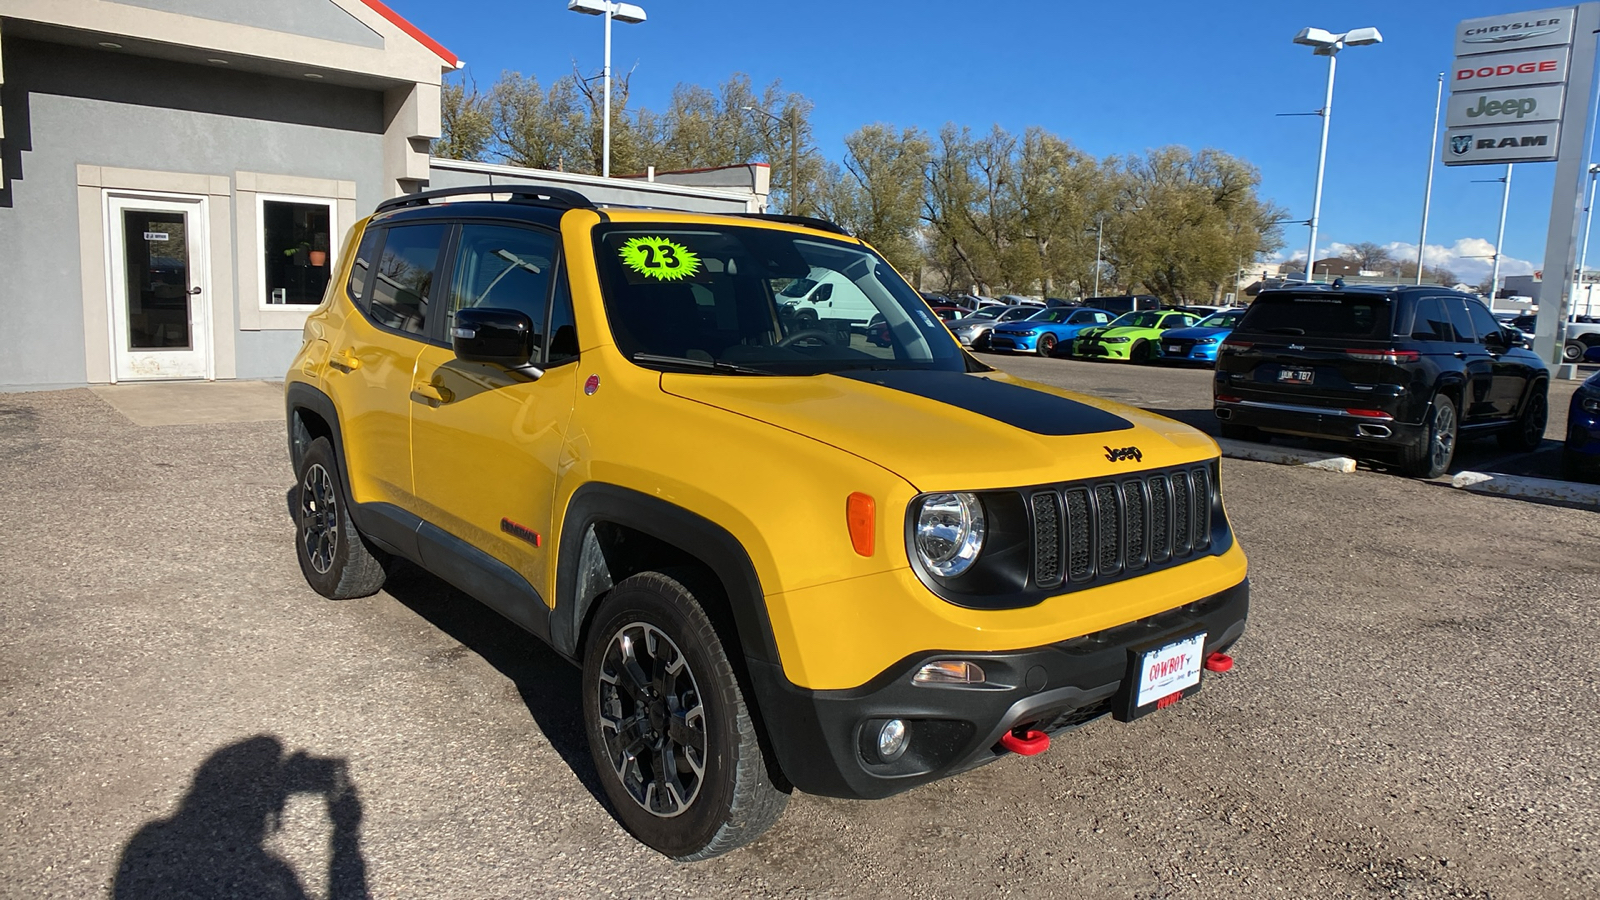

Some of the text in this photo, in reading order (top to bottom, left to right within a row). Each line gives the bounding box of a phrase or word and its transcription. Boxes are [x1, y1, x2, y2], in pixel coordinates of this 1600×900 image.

[1464, 18, 1561, 36] CHRYSLER
[1456, 60, 1558, 80] DODGE
[1466, 96, 1537, 119] Jeep
[1476, 135, 1548, 149] RAM
[637, 244, 680, 269] 23
[1103, 446, 1143, 462] Jeep
[1149, 653, 1187, 682] COWBOY
